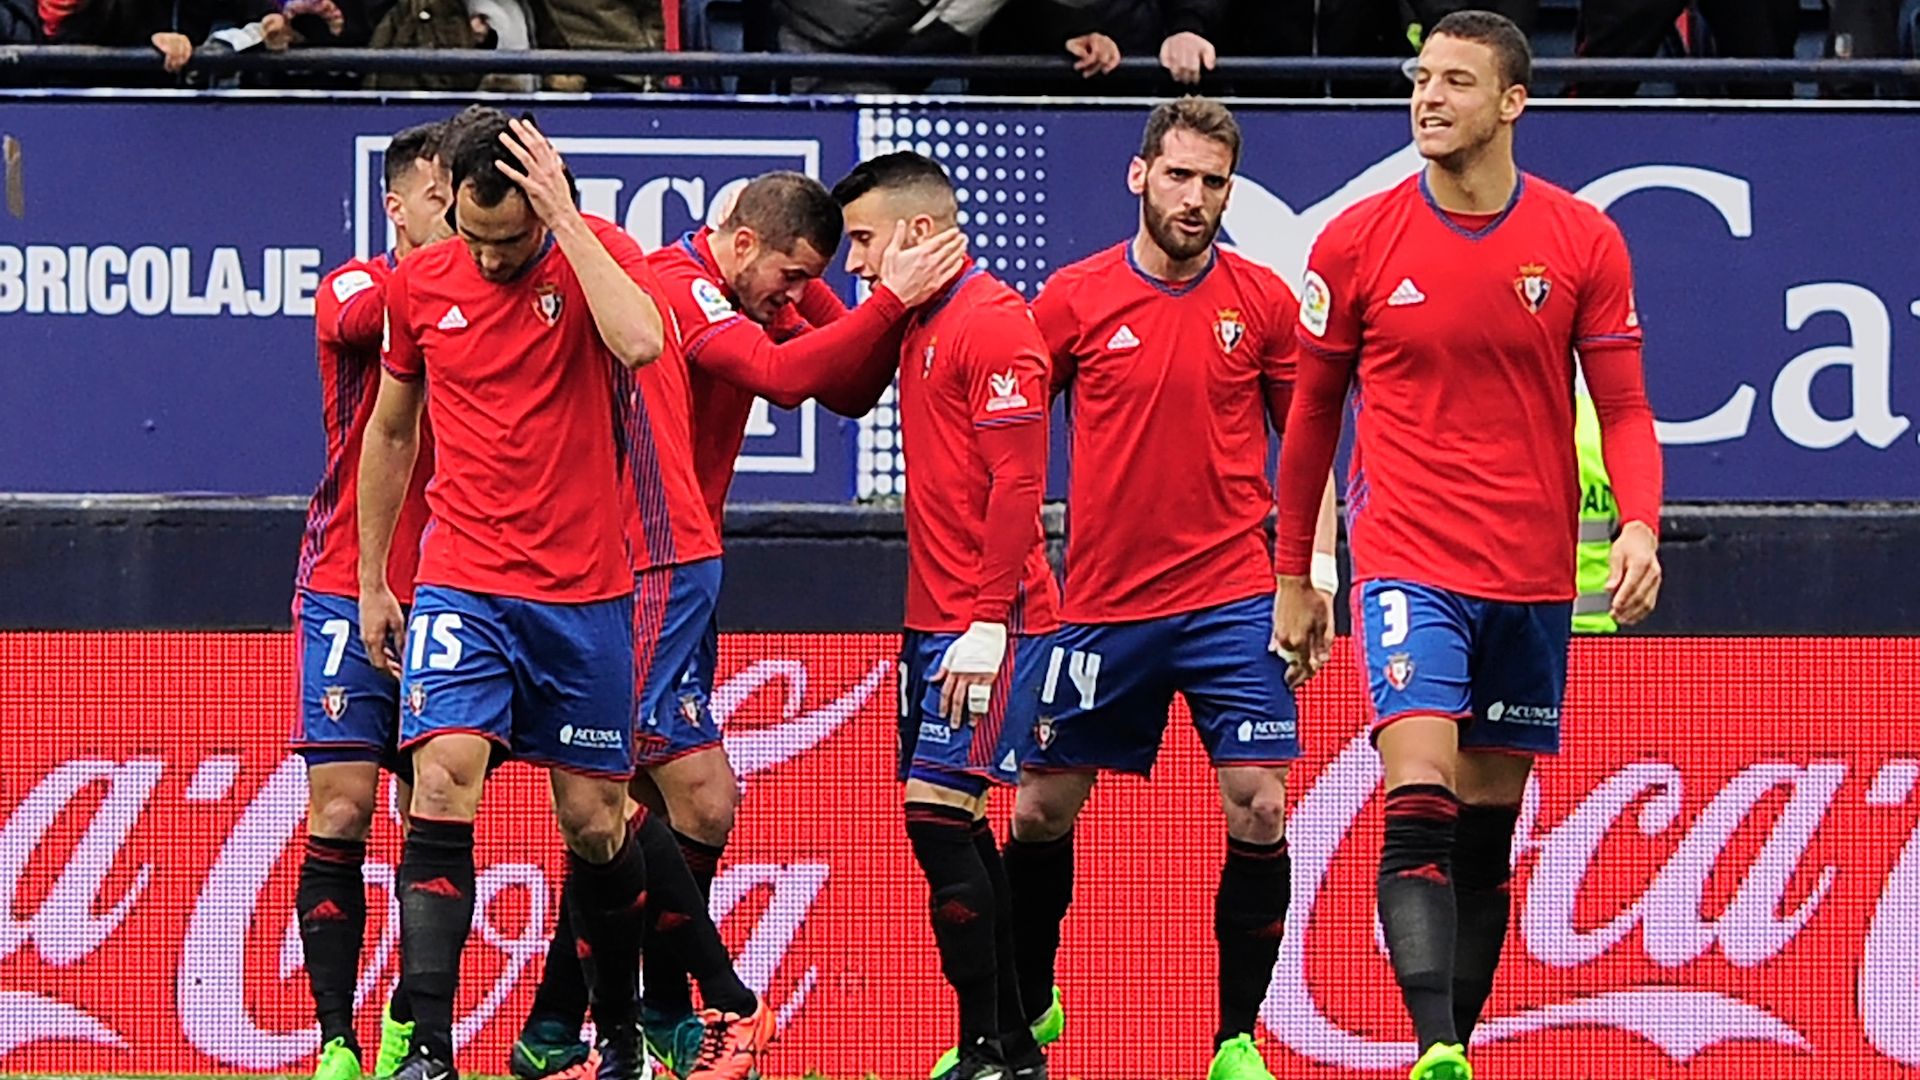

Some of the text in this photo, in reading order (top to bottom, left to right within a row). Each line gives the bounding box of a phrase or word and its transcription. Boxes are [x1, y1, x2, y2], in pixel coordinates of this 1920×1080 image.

[0, 245, 320, 316] BRICOLAJE
[1573, 165, 1920, 450] Ca
[320, 619, 350, 677] 7
[410, 613, 463, 671] 15
[1379, 589, 1408, 648] 3
[1041, 646, 1102, 710] 14
